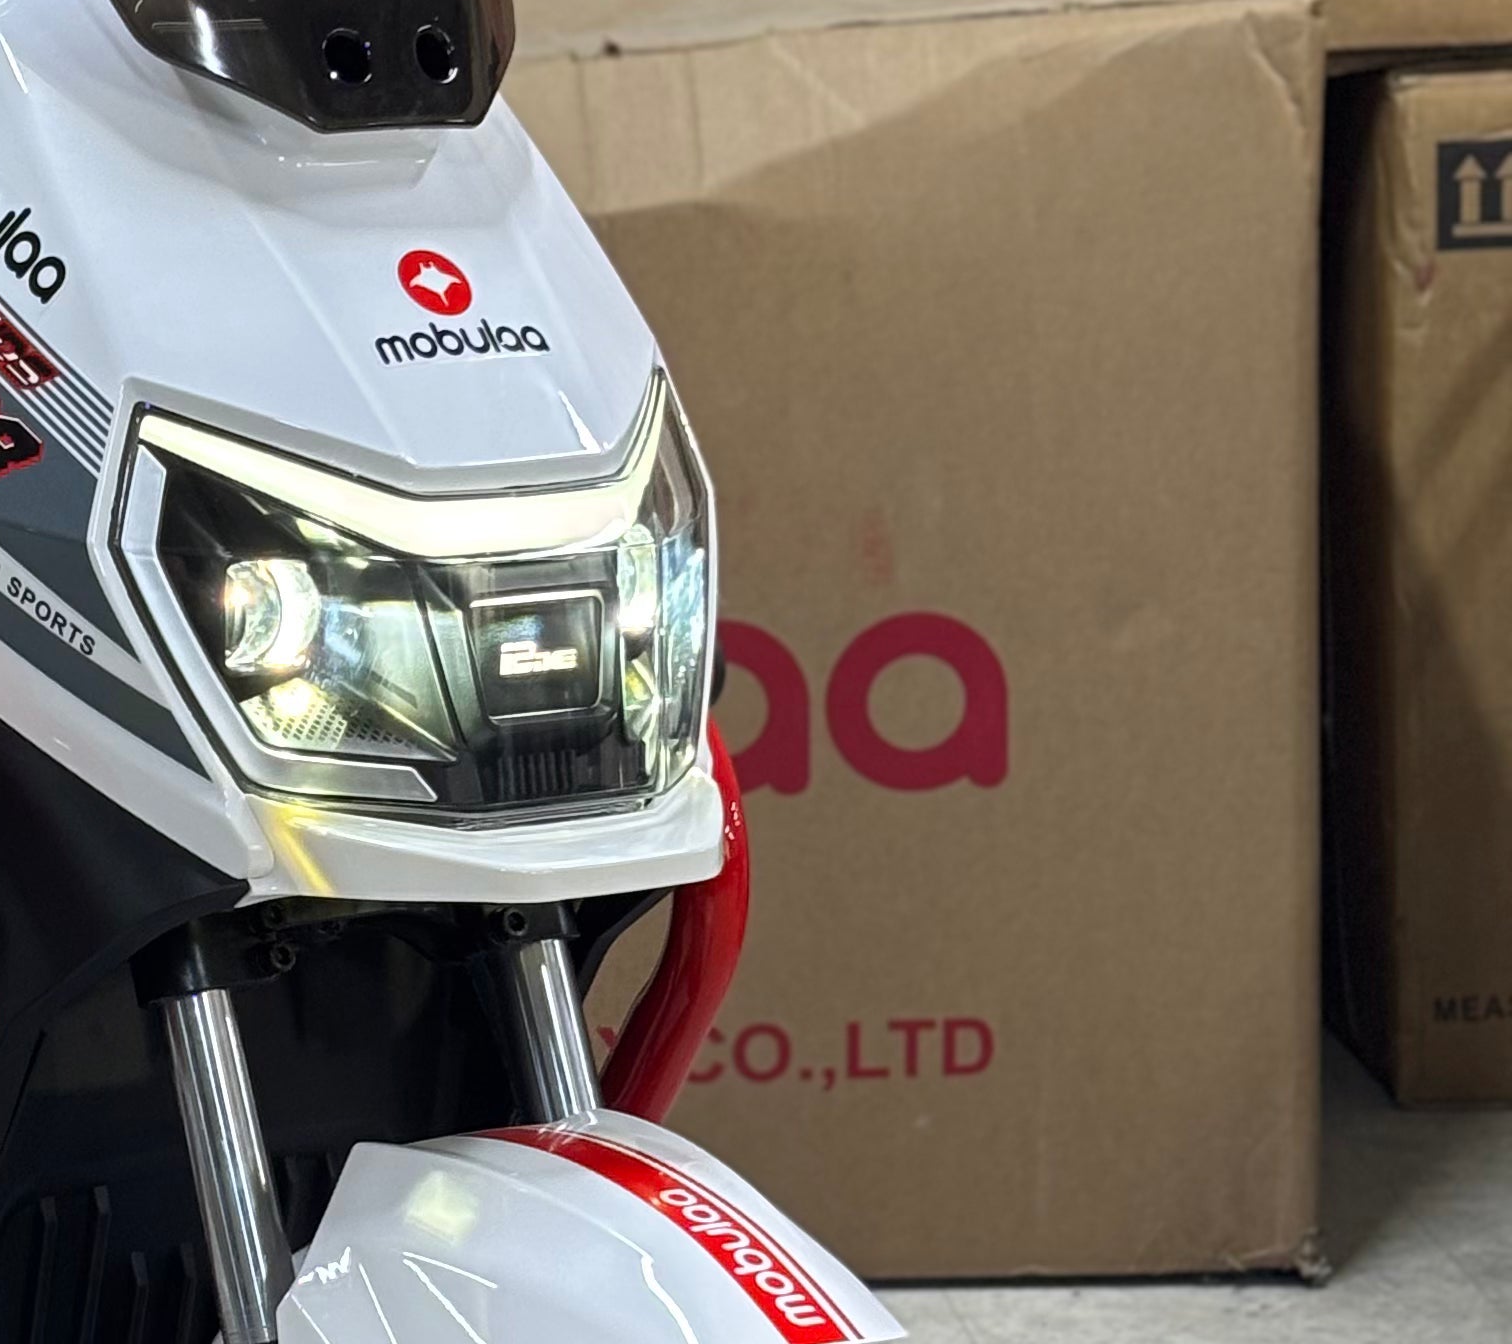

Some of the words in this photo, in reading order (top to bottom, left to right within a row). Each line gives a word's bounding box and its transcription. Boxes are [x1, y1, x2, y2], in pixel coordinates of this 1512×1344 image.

[375, 318, 550, 365] mobulaa
[7, 577, 96, 657] SPORTS
[1433, 994, 1512, 1023] MEA
[658, 1187, 827, 1328] mobulaa
